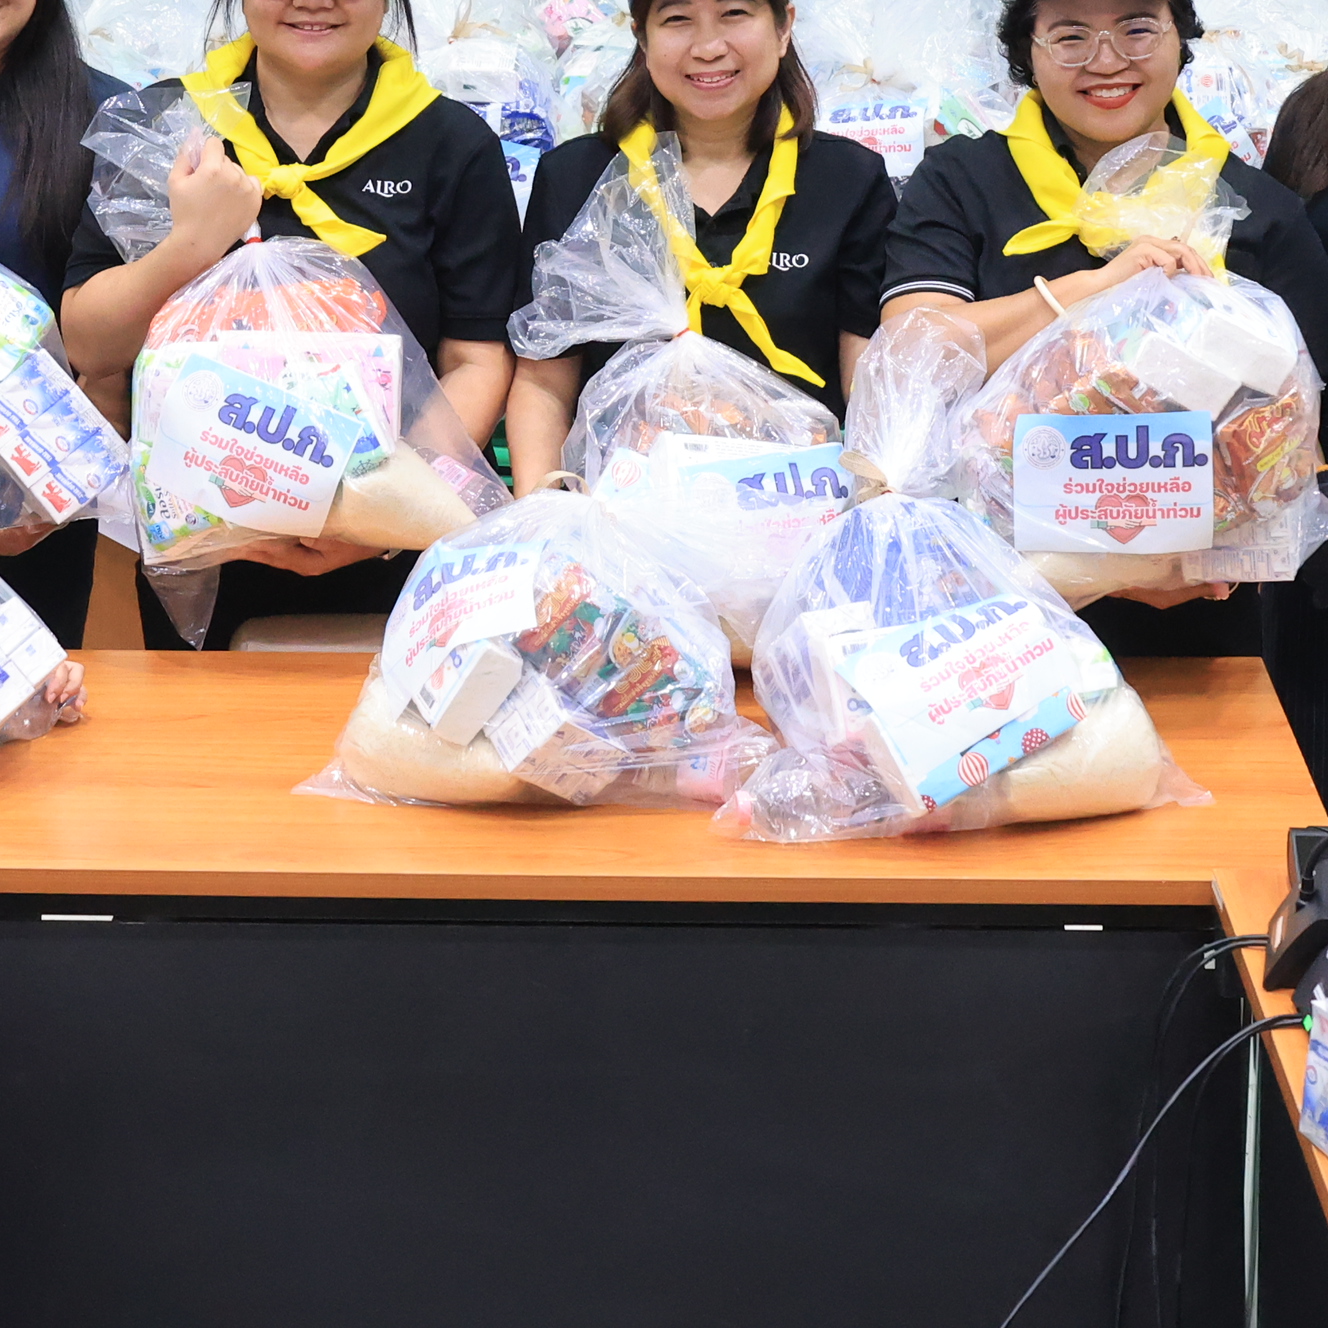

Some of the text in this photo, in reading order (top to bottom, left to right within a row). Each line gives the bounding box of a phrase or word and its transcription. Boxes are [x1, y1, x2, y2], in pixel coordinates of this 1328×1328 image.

[362, 179, 412, 198] ALRO
[768, 252, 809, 271] LRO
[218, 393, 333, 467] ส.ป.ก.
[1070, 425, 1208, 469] ส.ป.ก.
[182, 448, 310, 511] ผู้ประสบภัยน้ำท่วม
[199, 427, 310, 484] ร่วมใจช่วยเหลือ
[1063, 476, 1192, 494] ร่วมใจช่วยเหลือ
[1054, 499, 1202, 525] ผู้ประสบภัยน้ำท่วม
[412, 550, 529, 612] ส.ป.ก.
[900, 594, 1028, 668] ส.ป.ก.
